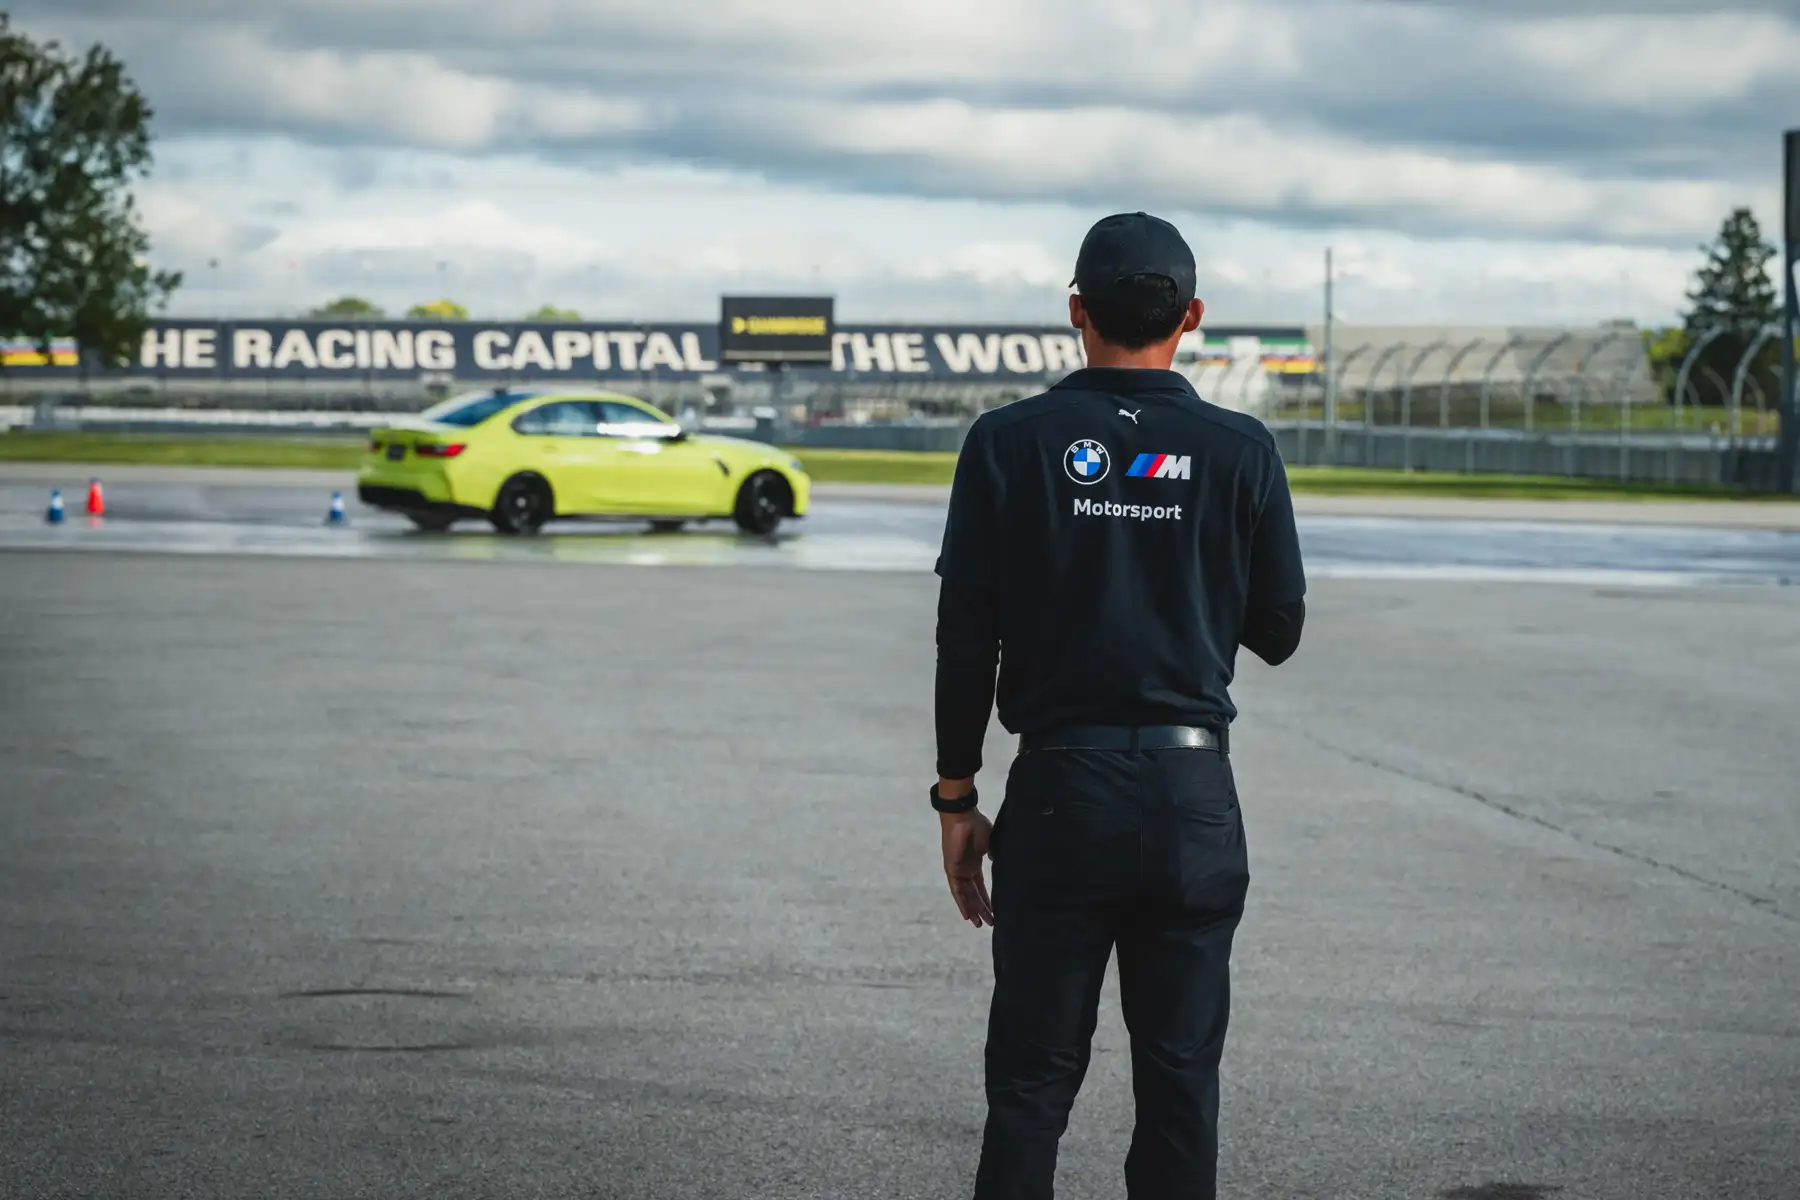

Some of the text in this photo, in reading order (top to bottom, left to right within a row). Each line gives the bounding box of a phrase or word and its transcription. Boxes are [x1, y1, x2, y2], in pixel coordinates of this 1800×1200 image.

[140, 328, 218, 369] HE
[233, 329, 456, 370] RACING
[472, 330, 718, 371] CAPITAL
[933, 332, 1088, 373] WOR
[1070, 441, 1105, 455] BMW
[1153, 454, 1192, 480] M
[1073, 498, 1183, 521] Motorsport
